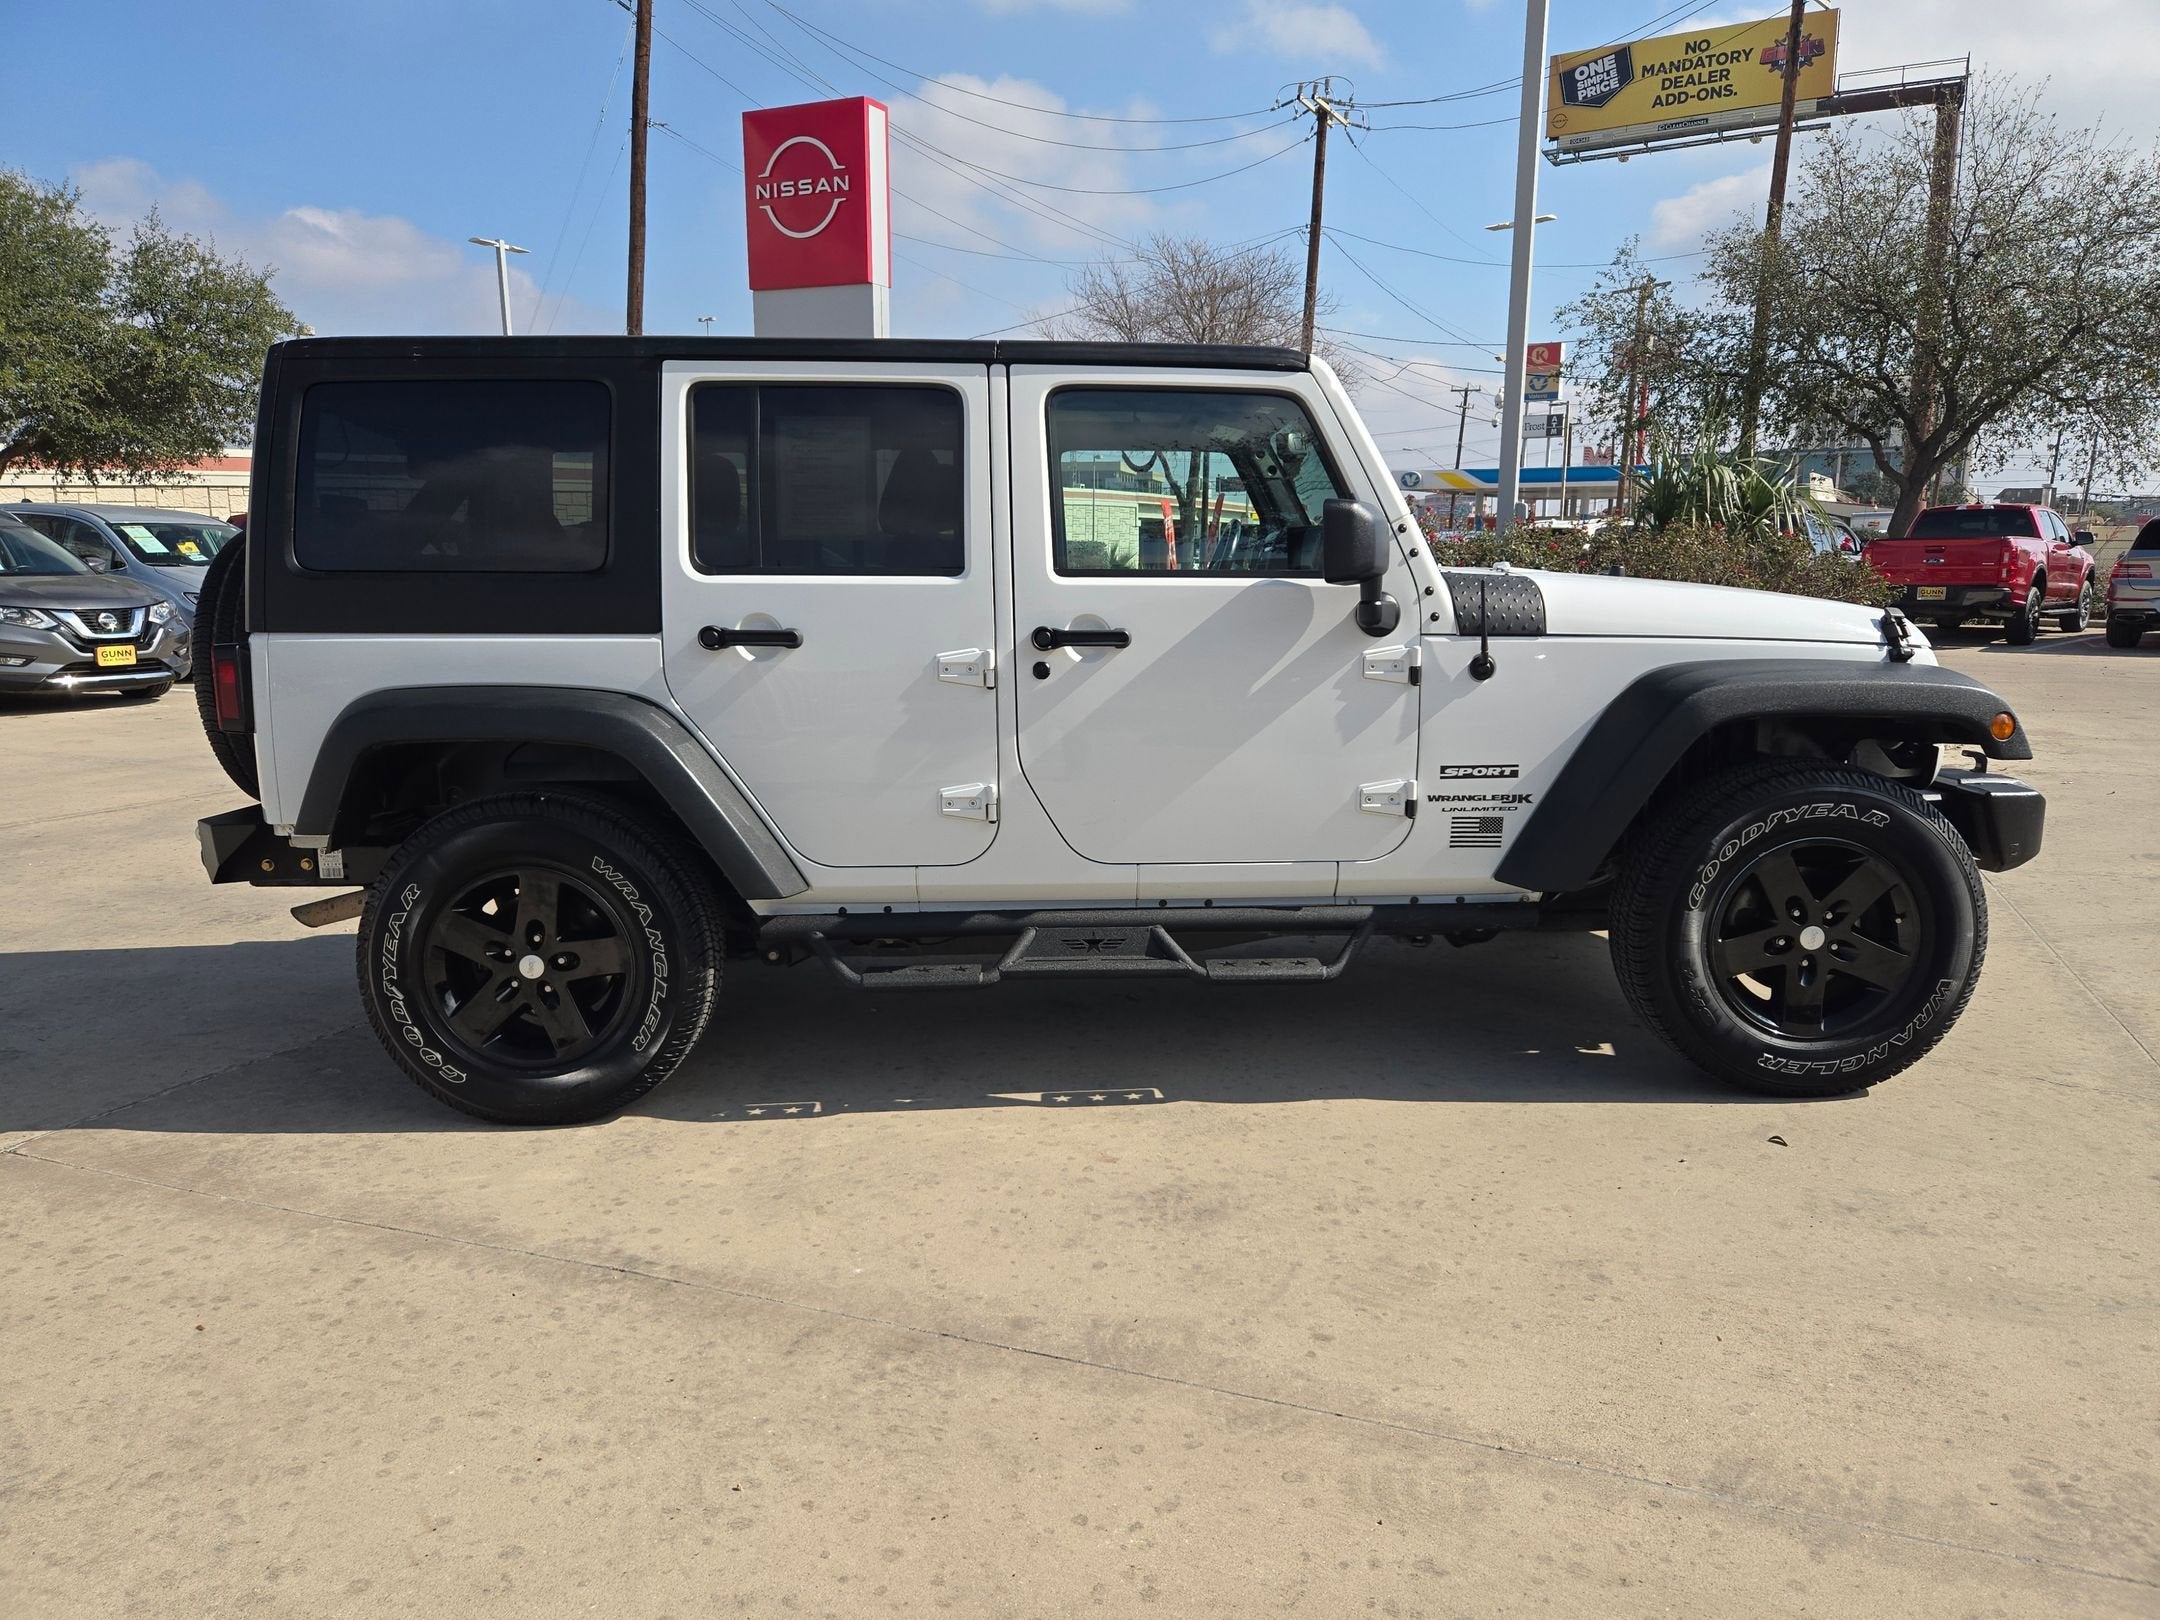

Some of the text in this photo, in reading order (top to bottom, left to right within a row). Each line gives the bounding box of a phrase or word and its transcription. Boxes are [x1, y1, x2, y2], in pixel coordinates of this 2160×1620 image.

[1684, 39, 1711, 55] NO
[1574, 54, 1617, 81] ONE
[1641, 48, 1754, 77] MANDATORY
[1577, 69, 1617, 90] SIMPLE
[1577, 78, 1620, 101] PRICE
[1661, 69, 1731, 91] DEALER
[1652, 84, 1738, 108] ADD-ONS.
[756, 175, 849, 199] NISSAN
[1535, 349, 1546, 360] K
[1524, 422, 1546, 431] Frost
[1550, 415, 1558, 435] ATM
[101, 649, 132, 658] GUNN
[1440, 766, 1519, 778] SPORT
[1427, 794, 1511, 802] WRANGLER
[1688, 803, 1890, 910] GOODYEAR
[591, 856, 668, 1051] WRANGLER
[382, 883, 467, 1084] GOODYEAR
[1757, 978, 1954, 1075] WRANGLER
